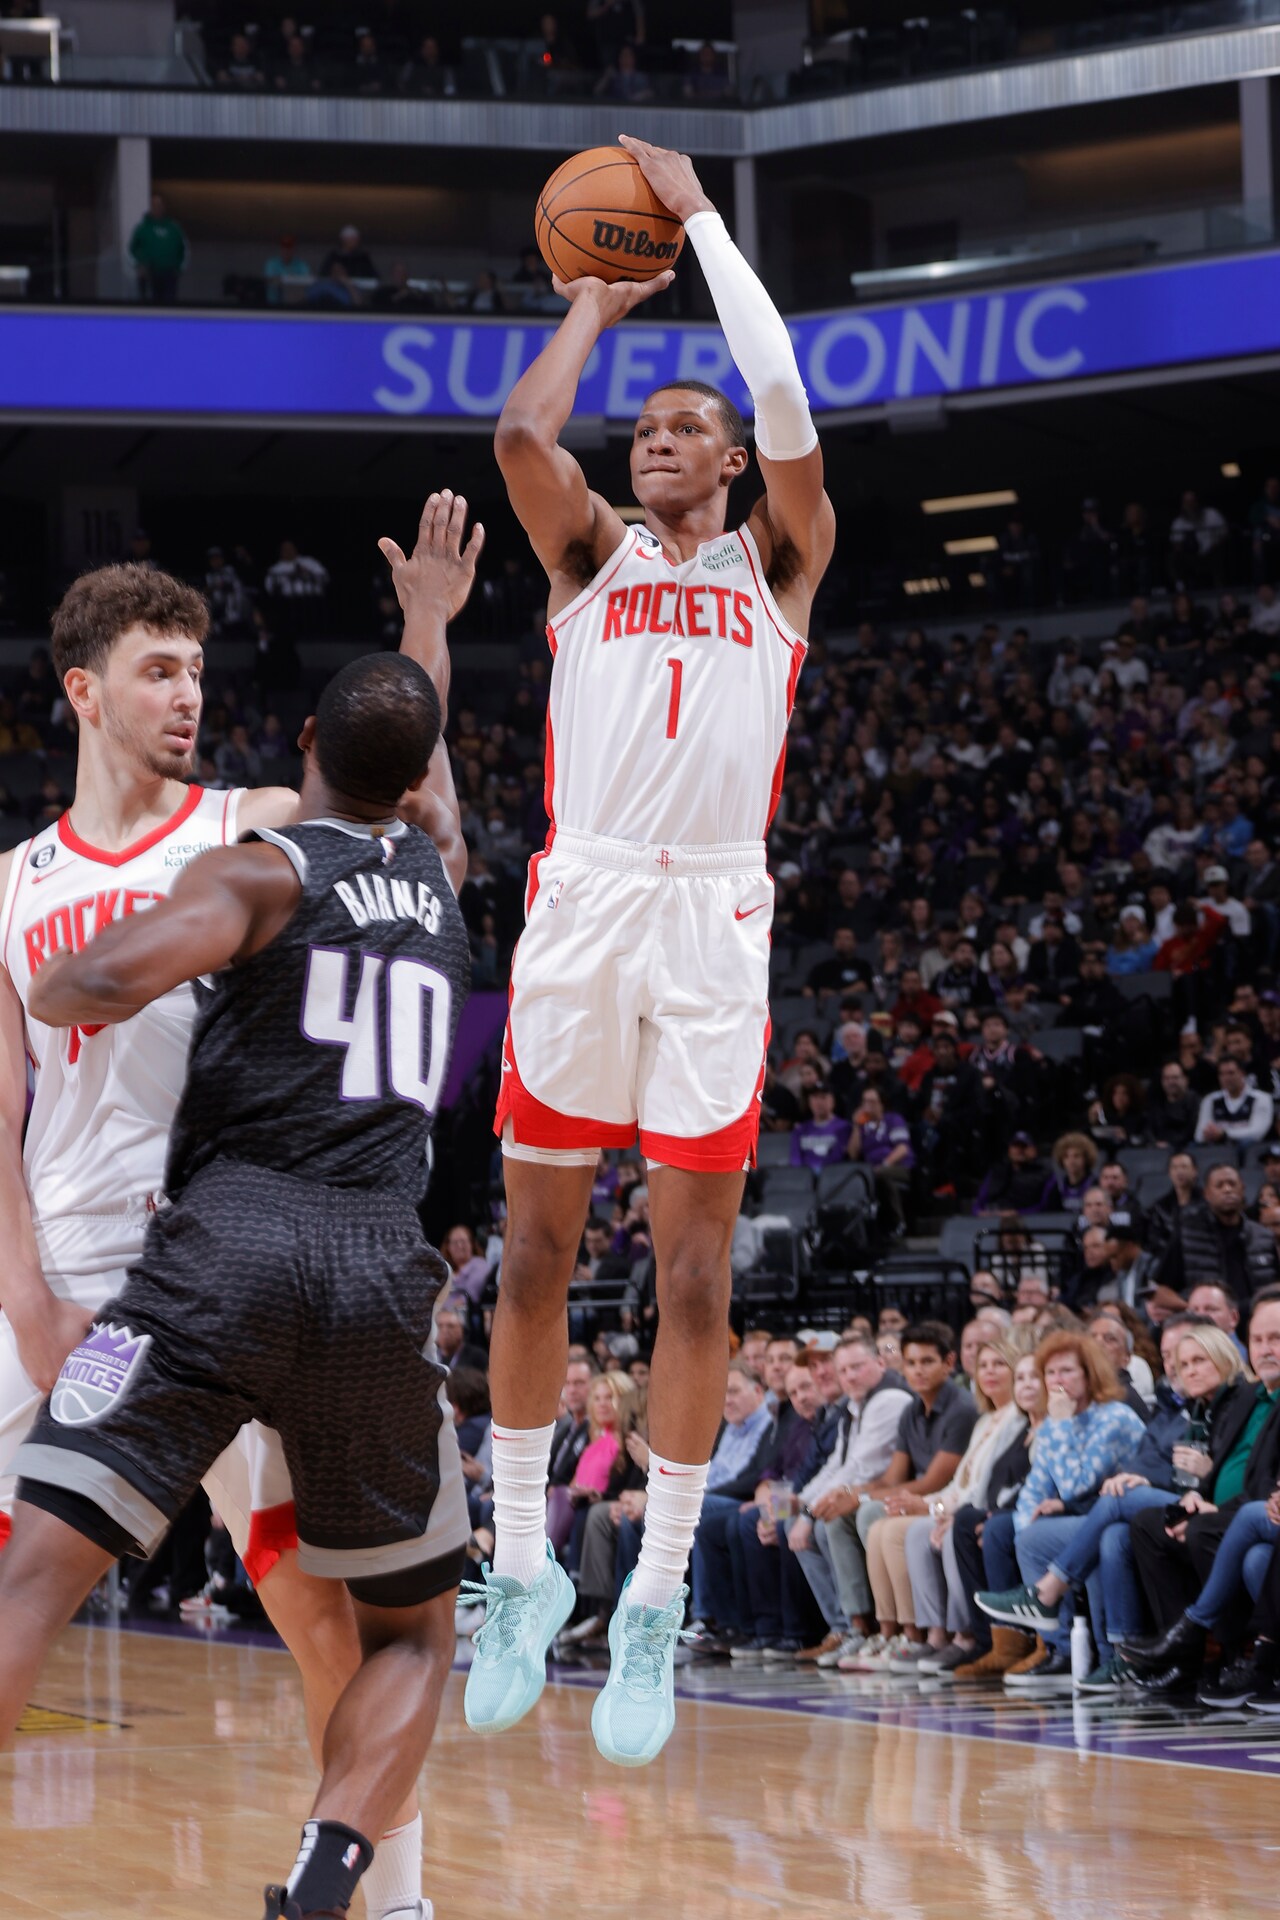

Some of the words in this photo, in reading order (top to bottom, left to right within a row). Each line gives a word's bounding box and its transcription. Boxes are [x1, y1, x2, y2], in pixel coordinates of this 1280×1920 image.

[593, 219, 678, 260] Wilson
[373, 287, 1088, 416] SUERONIC
[602, 582, 753, 649] ROCKETS
[666, 658, 683, 740] 1
[165, 855, 191, 868] kar
[24, 889, 169, 976] ROCKE
[333, 874, 443, 937] BARNES
[302, 944, 452, 1116] 40
[62, 1358, 124, 1394] KINGS
